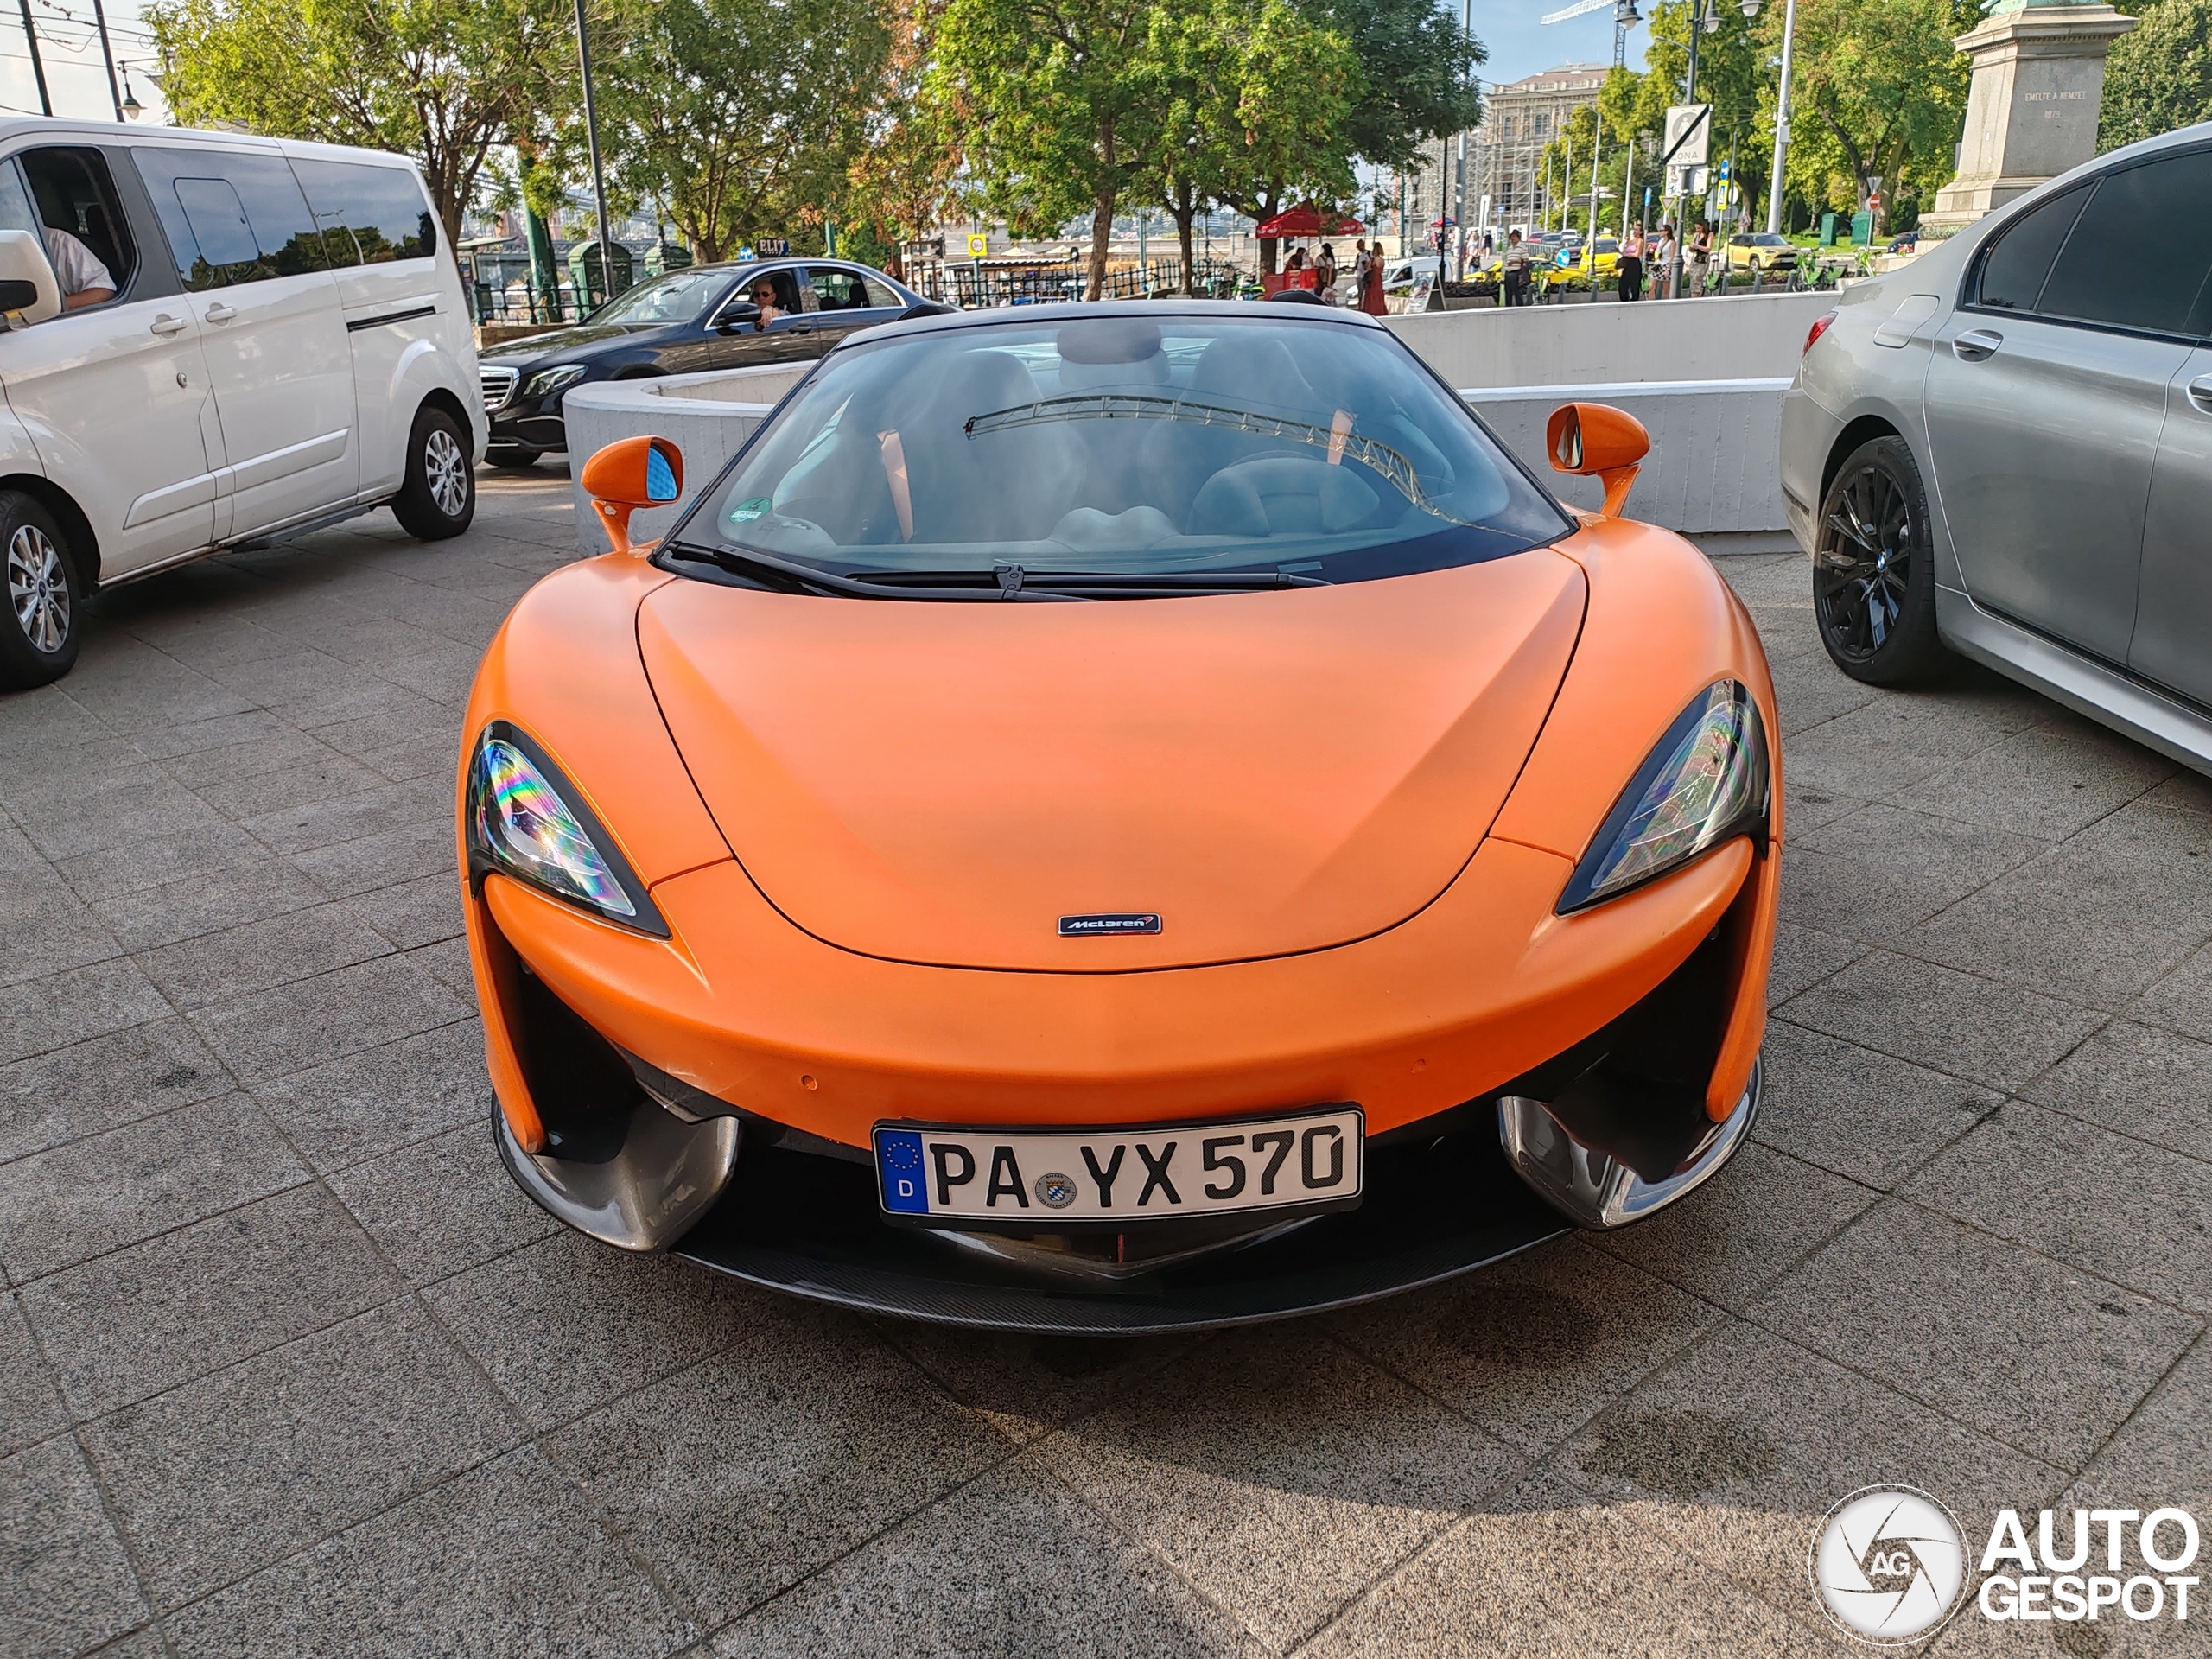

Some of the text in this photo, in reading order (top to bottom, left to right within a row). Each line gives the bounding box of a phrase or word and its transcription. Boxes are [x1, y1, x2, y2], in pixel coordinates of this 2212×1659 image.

[2024, 92, 2050, 102] EMELTE
[759, 239, 785, 256] ELIT
[1067, 920, 1145, 929] McLaren
[929, 1124, 1344, 1208] PA YX 570
[898, 1179, 914, 1197] D
